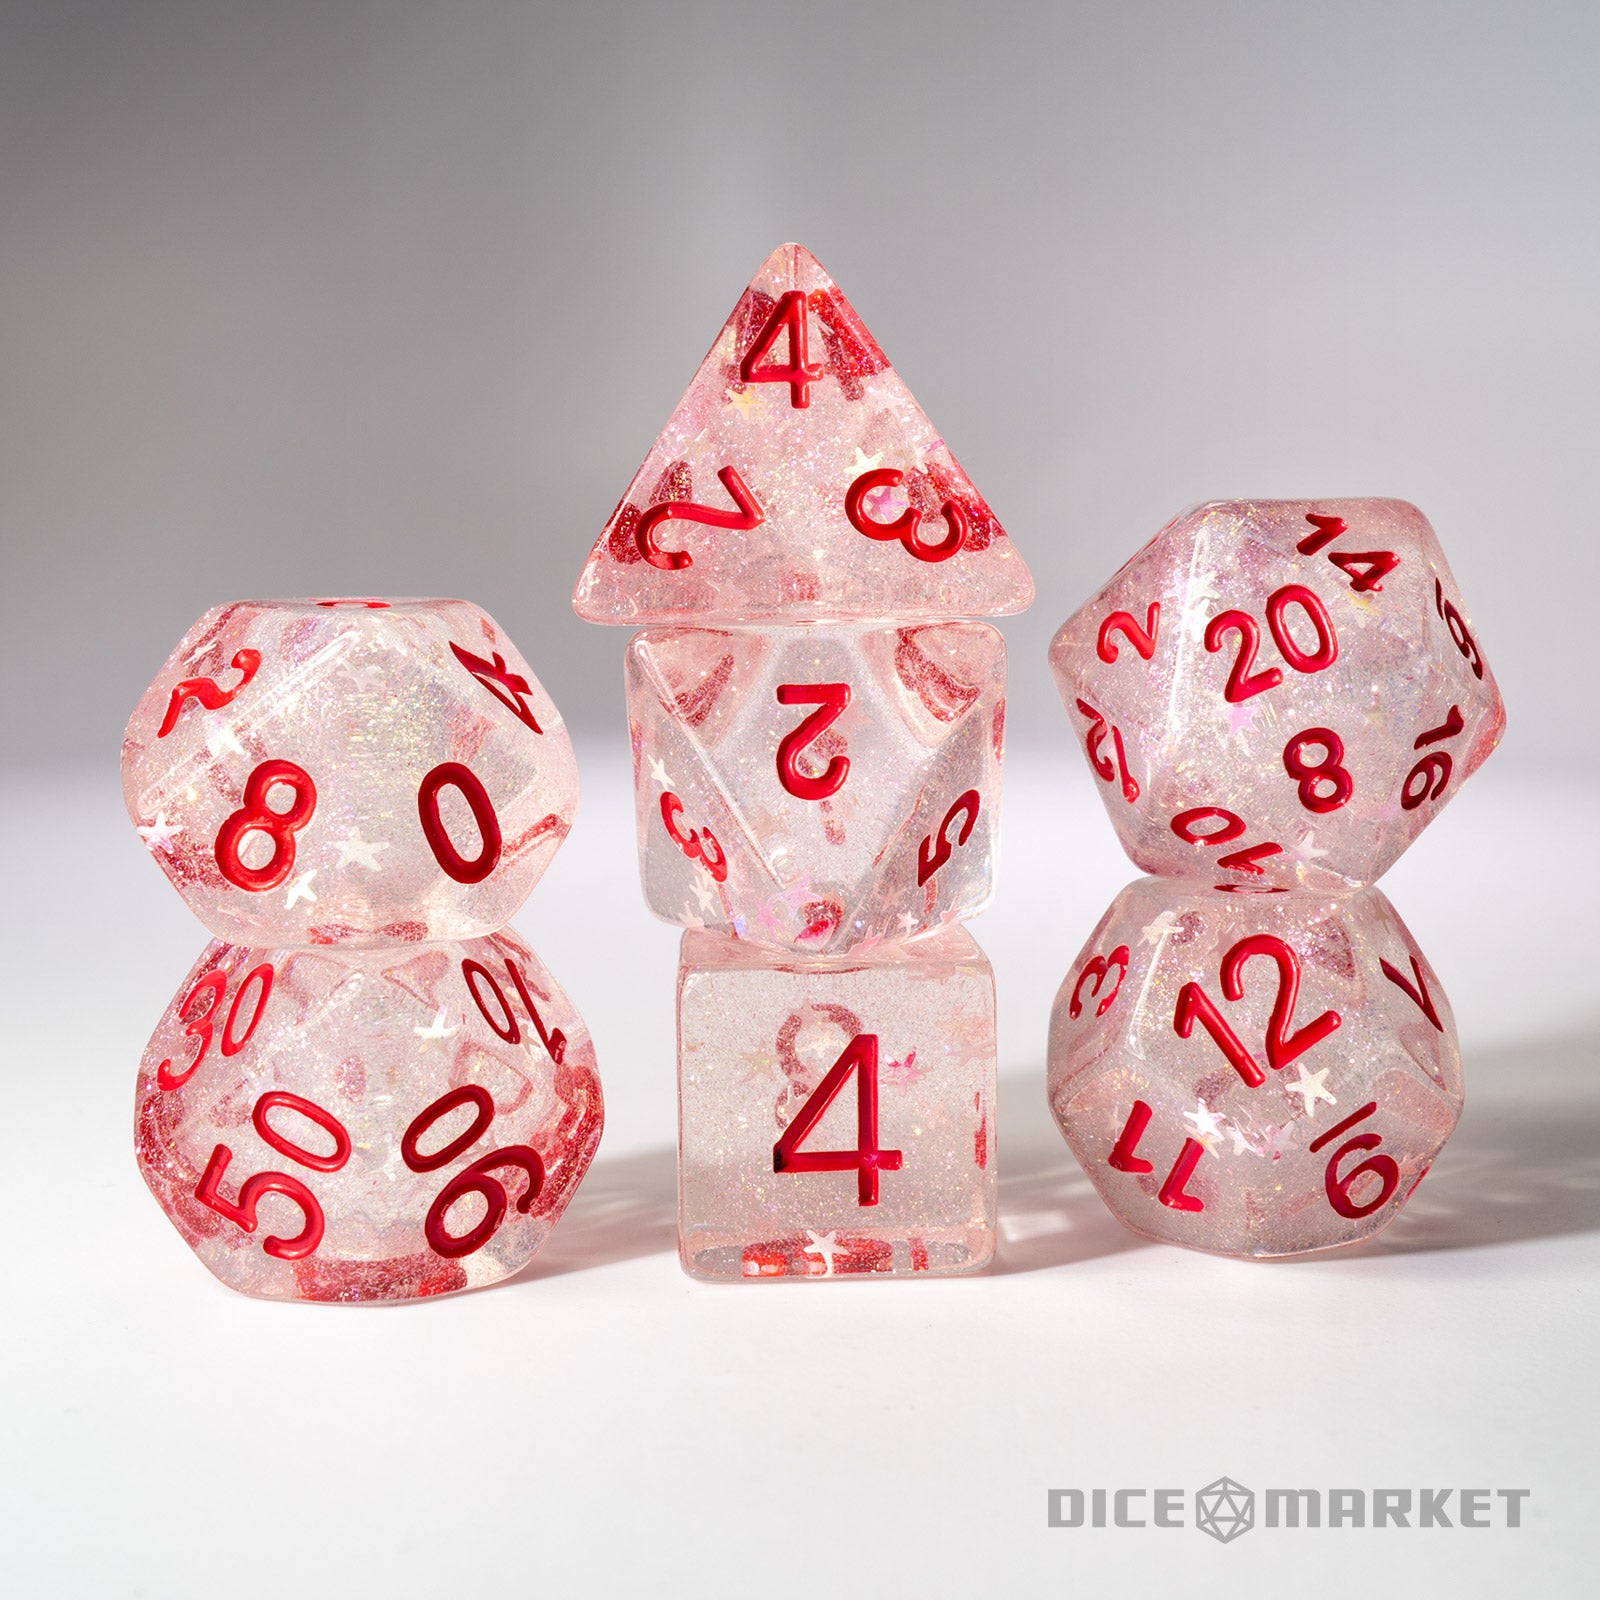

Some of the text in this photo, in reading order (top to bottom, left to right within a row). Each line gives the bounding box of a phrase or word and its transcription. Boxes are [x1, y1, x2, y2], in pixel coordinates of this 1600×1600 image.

[740, 290, 824, 409] 4
[634, 465, 766, 571] 2
[844, 467, 969, 564] 3
[1296, 513, 1401, 593] 14
[1097, 601, 1161, 664] 2
[1204, 584, 1339, 703] 20
[775, 683, 852, 801] 2
[1282, 727, 1353, 814] 8
[1400, 704, 1465, 811] 16
[214, 758, 317, 893] 8
[417, 761, 502, 885] 0
[659, 790, 728, 882] 3
[1170, 806, 1284, 876] 10
[156, 962, 275, 1092] 30
[462, 958, 567, 1065] 10
[1069, 944, 1131, 1020] 3
[1173, 933, 1342, 1089] 12
[772, 1033, 904, 1207] 4
[1107, 1100, 1206, 1213] 11
[194, 1091, 352, 1261] 50
